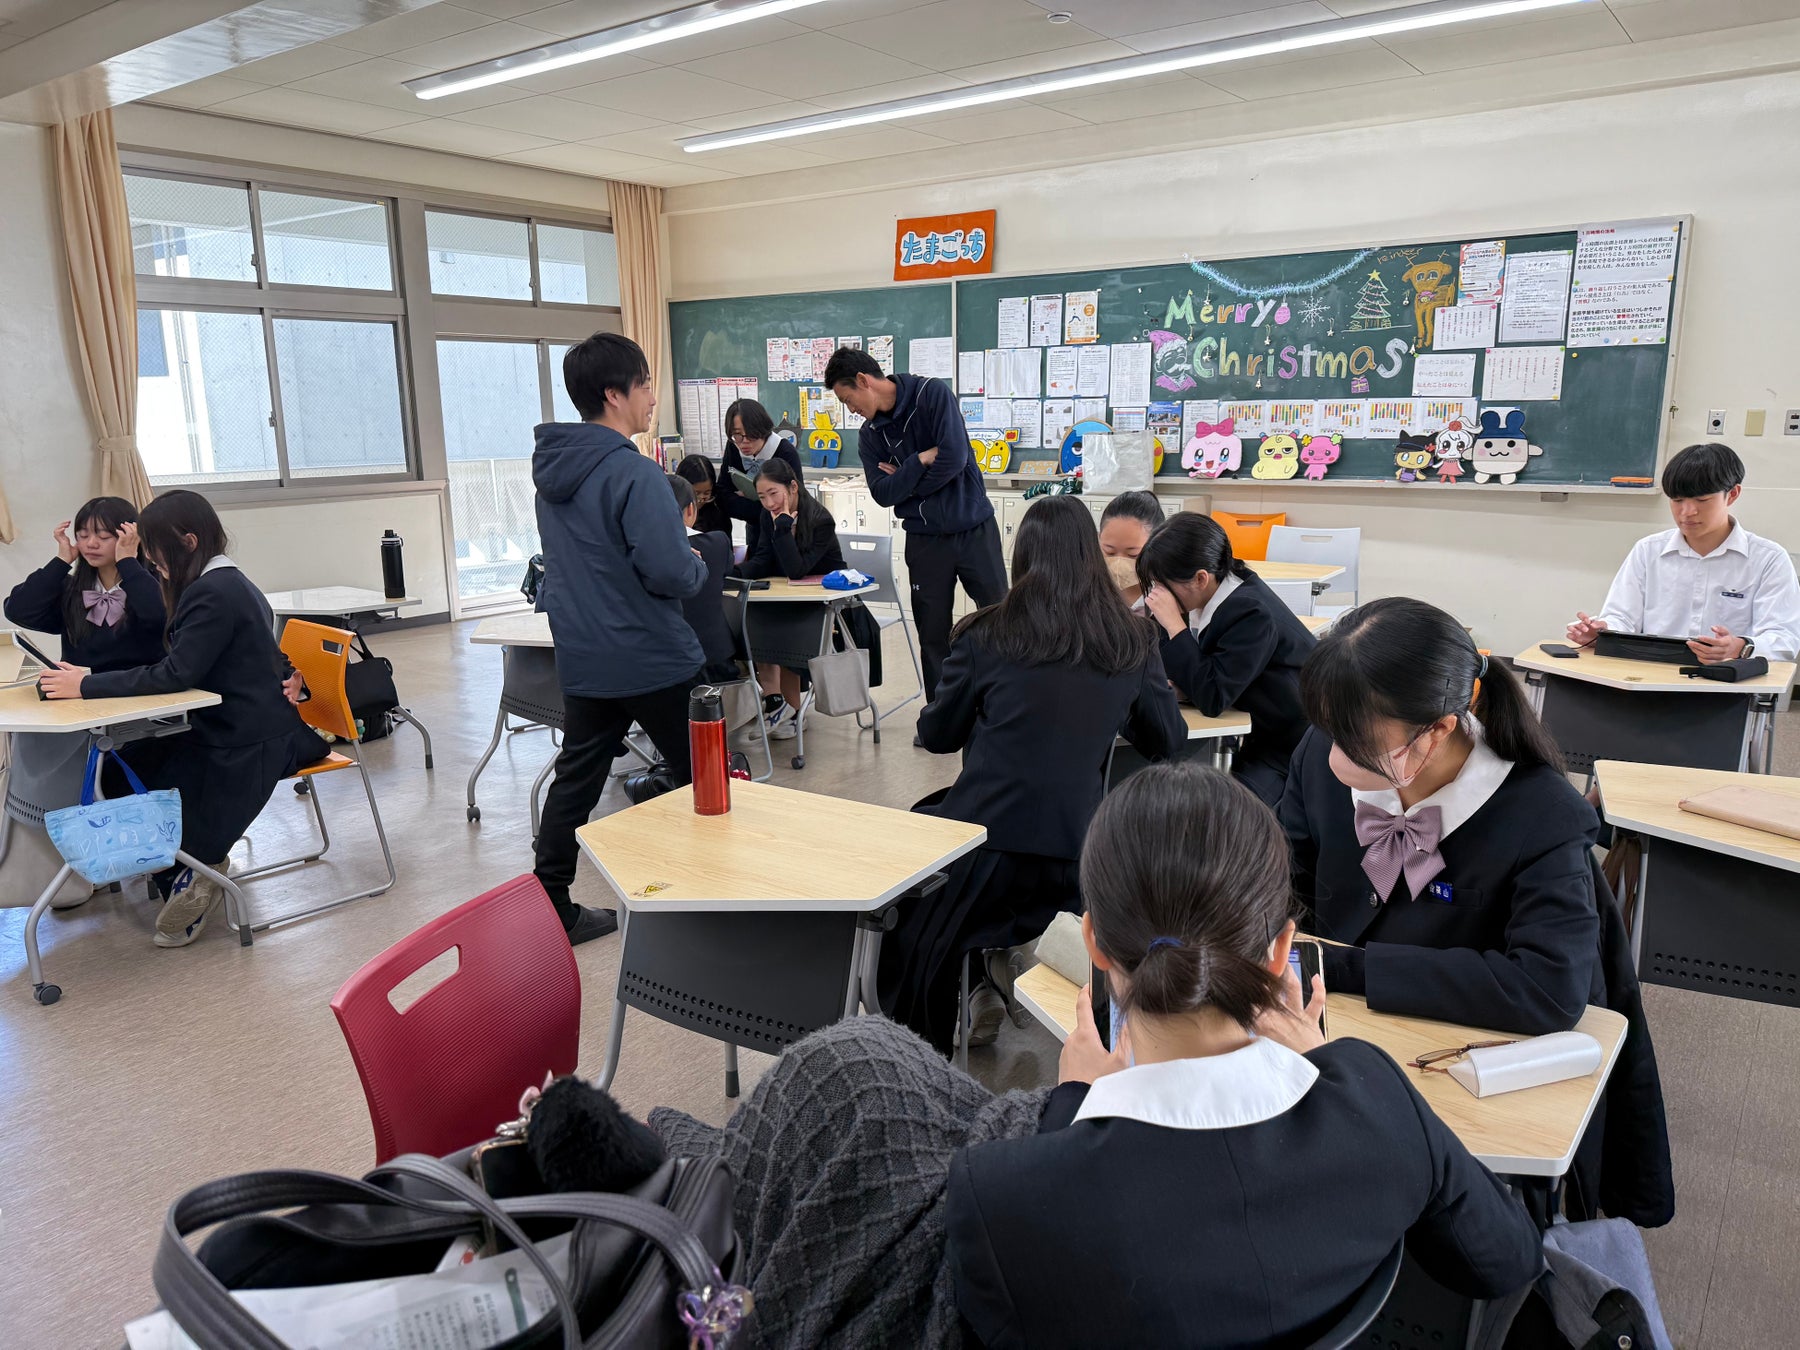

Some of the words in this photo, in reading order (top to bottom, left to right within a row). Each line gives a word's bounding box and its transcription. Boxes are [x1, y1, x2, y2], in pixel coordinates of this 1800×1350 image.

[903, 232, 984, 263] たまごっち
[1163, 293, 1276, 328] Merry
[1193, 336, 1408, 379] Christmas
